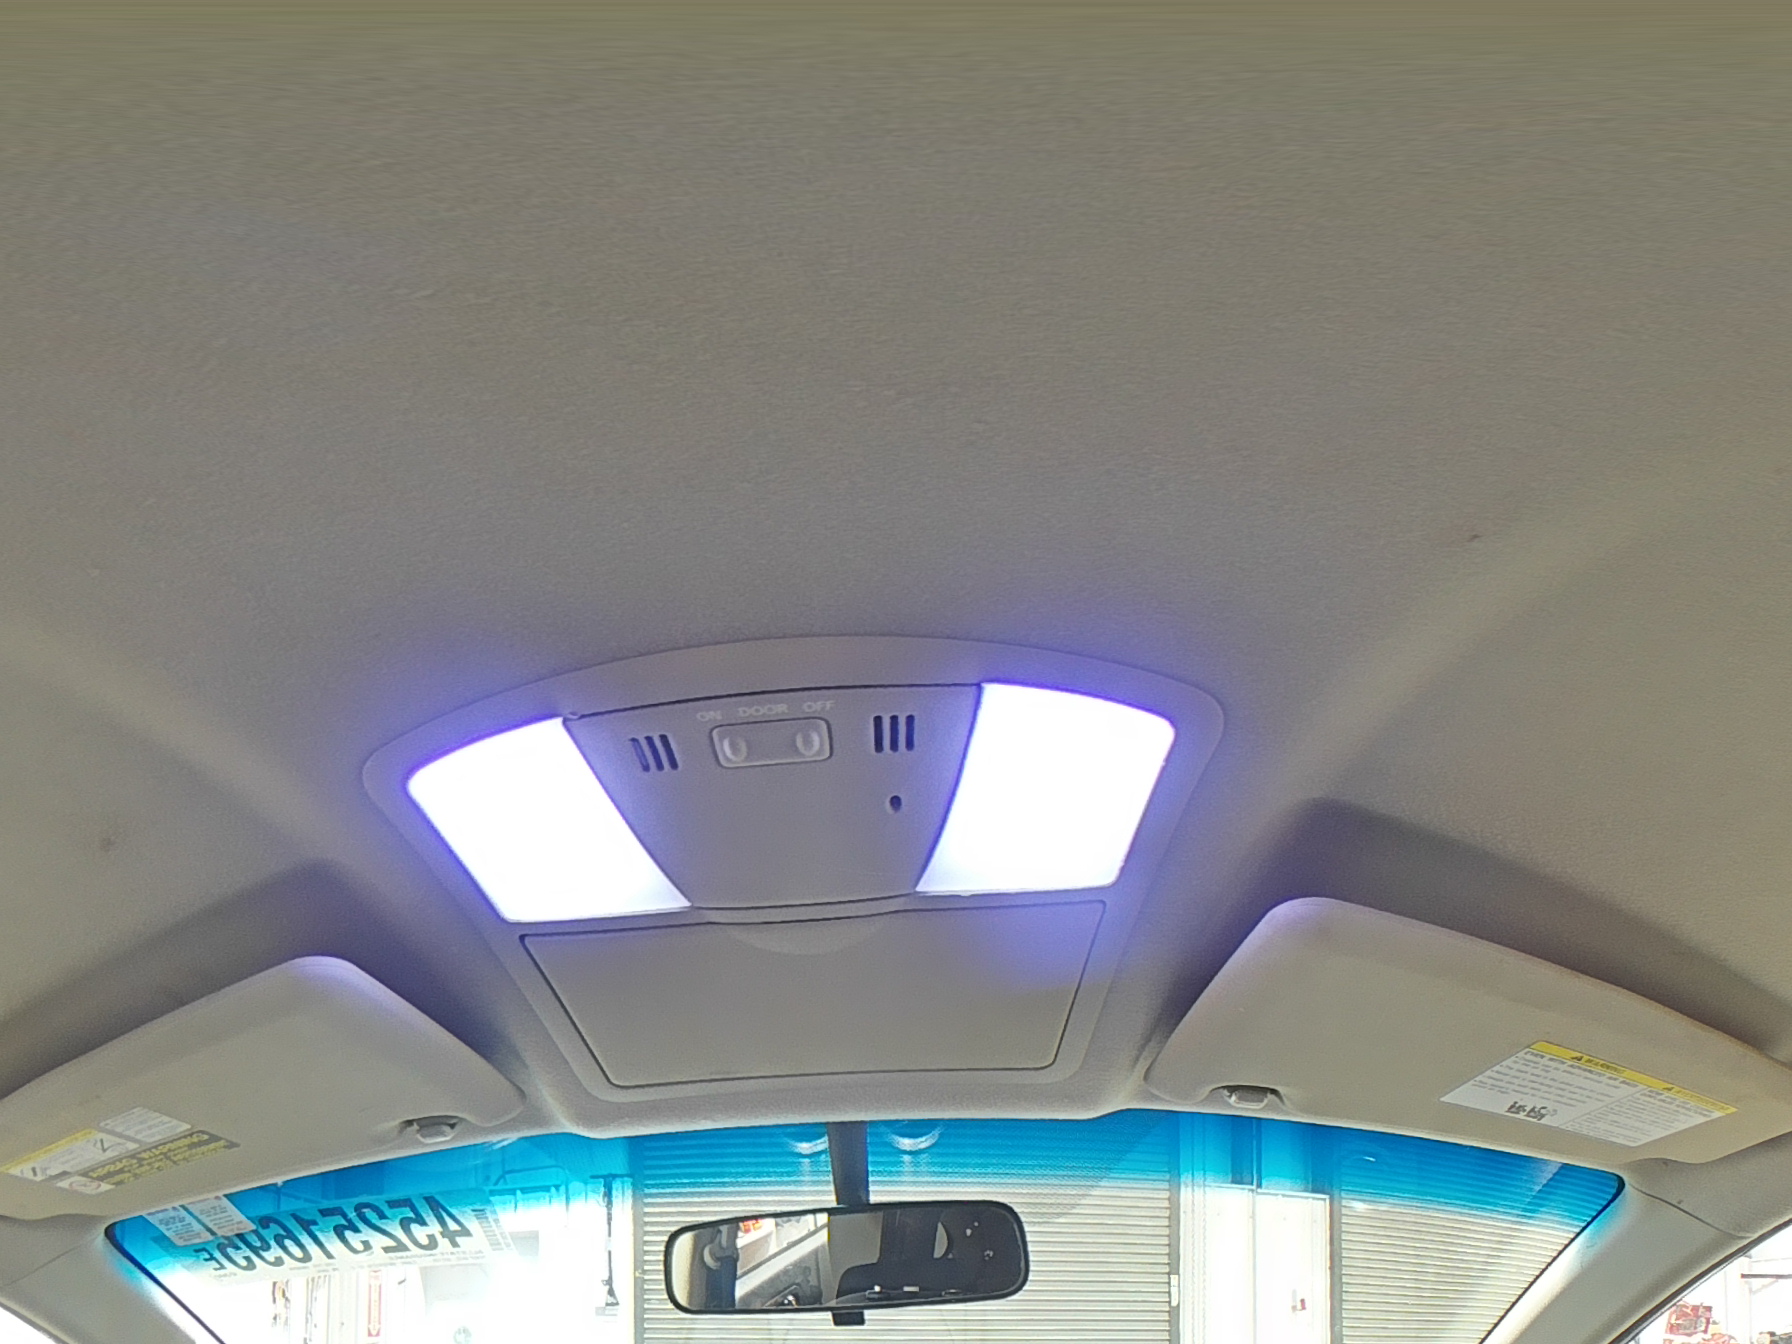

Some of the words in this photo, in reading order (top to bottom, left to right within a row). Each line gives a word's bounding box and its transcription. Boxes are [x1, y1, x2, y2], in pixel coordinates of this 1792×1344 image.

[696, 710, 722, 723] ON
[738, 702, 789, 718] DOOR
[802, 699, 837, 713] OFF
